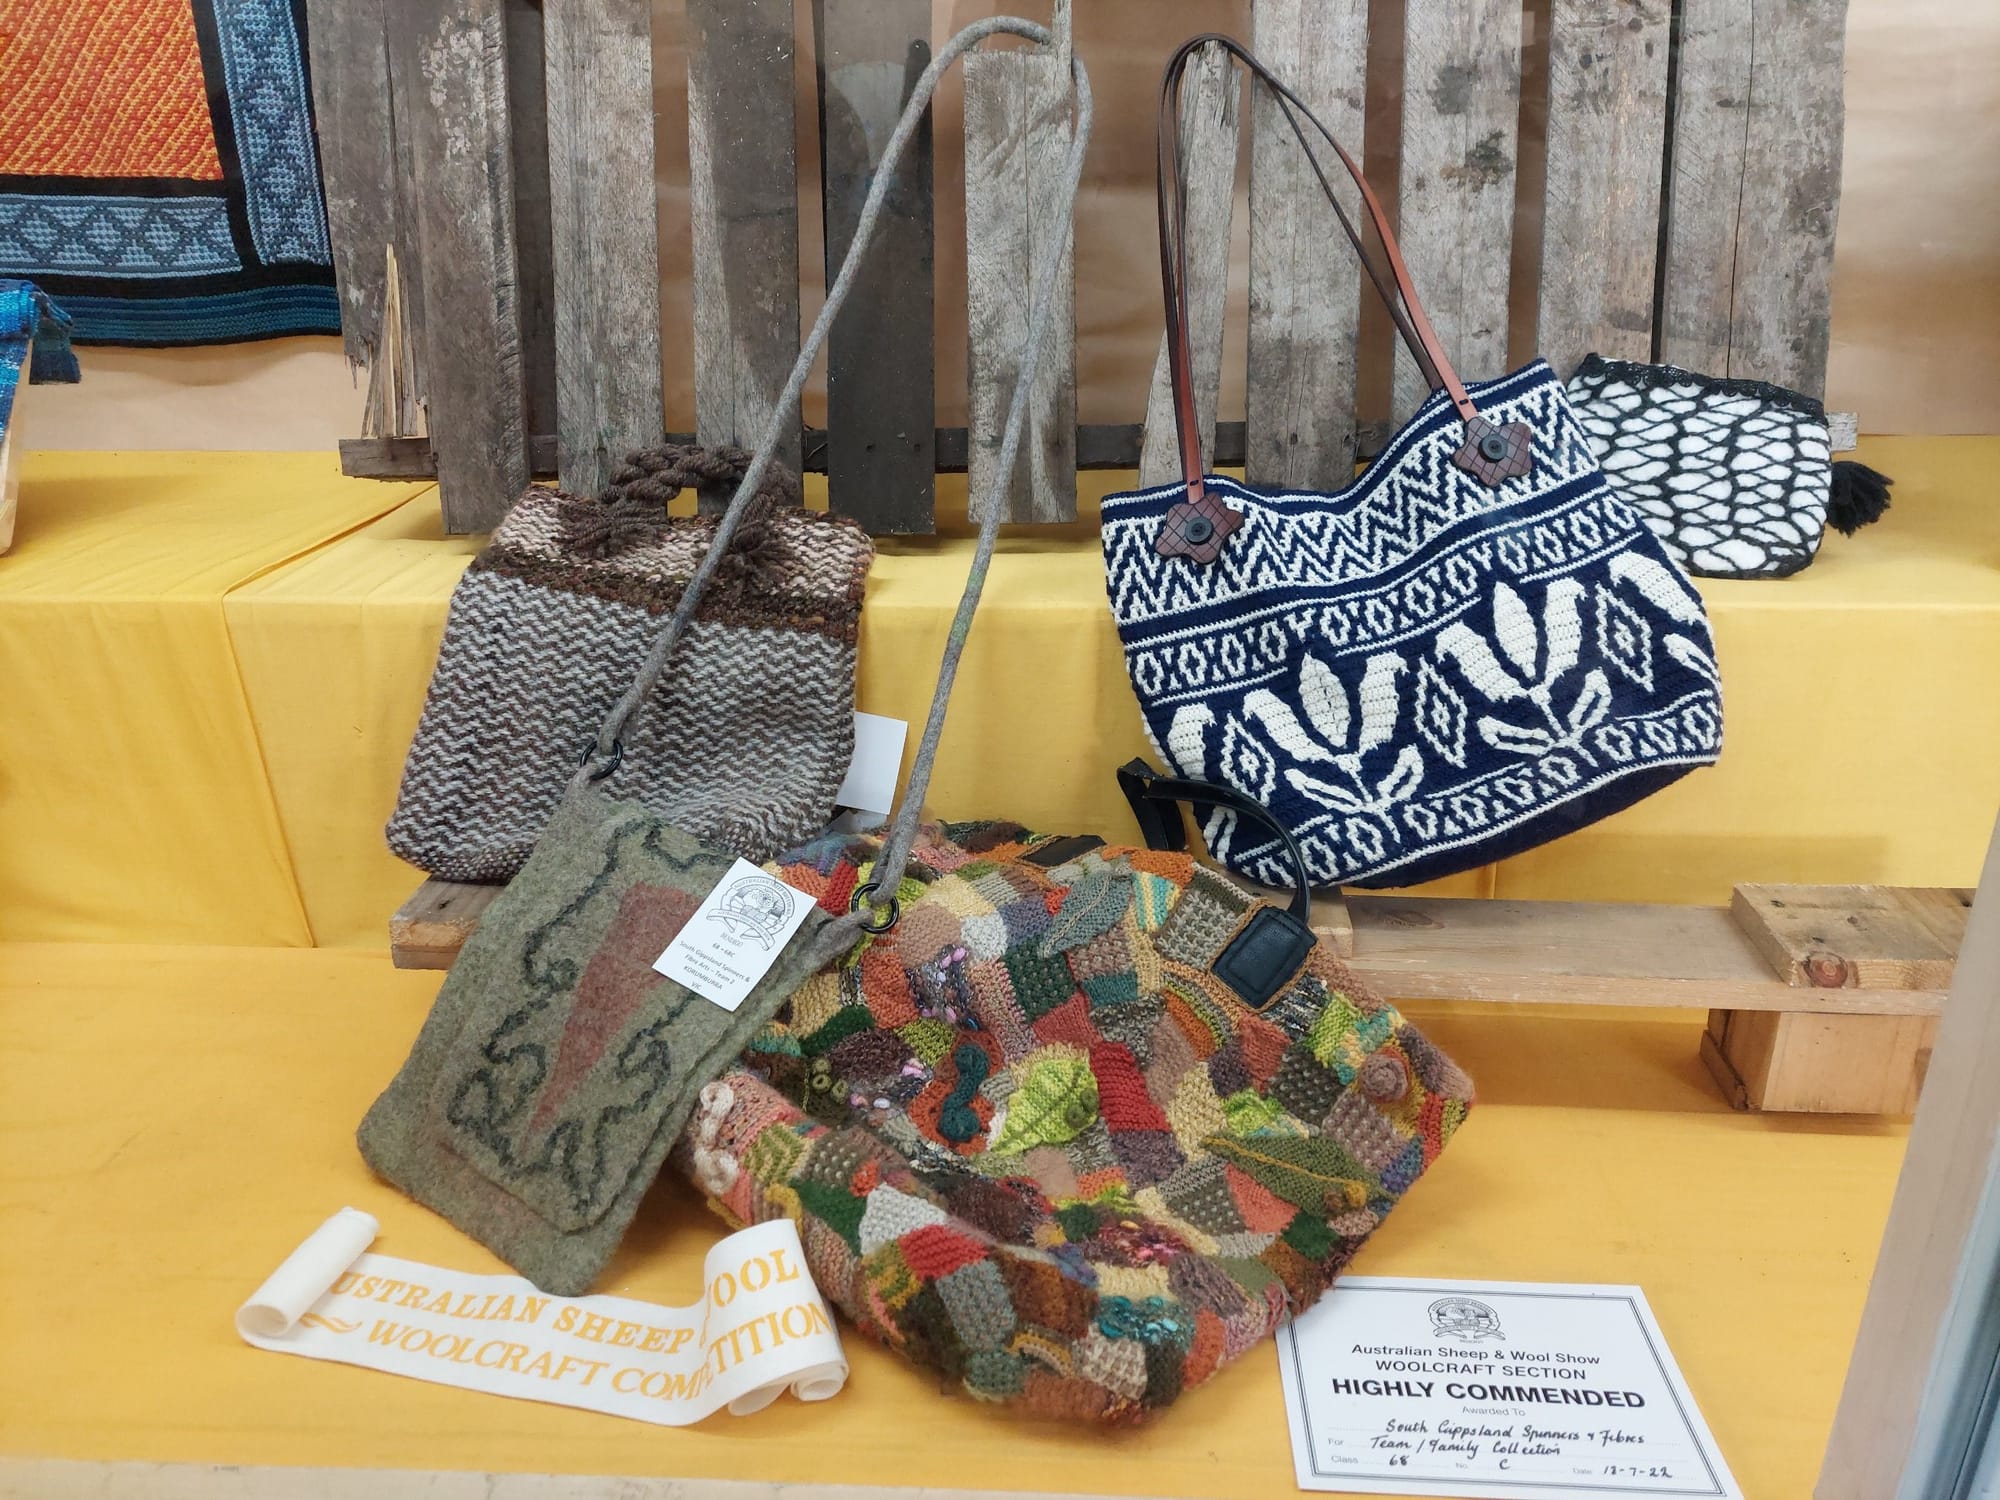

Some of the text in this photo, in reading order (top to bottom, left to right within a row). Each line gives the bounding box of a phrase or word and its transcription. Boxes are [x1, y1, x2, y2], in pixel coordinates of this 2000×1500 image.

[680, 940, 696, 953] South
[330, 1271, 551, 1324] USTRALIAN
[552, 1305, 695, 1356] SHEEP
[368, 1318, 610, 1387] WOOLCRAFT
[1351, 1344, 1601, 1365] Australian Sheep & Wool Show
[1375, 1359, 1587, 1380] WOOLCRAFT SECTION
[1332, 1378, 1646, 1409] HIGHLY COMMENDED
[1462, 1406, 1526, 1417] Awarded To
[1385, 1418, 1429, 1434] South
[1328, 1438, 1344, 1447] For
[1370, 1434, 1412, 1450] Team
[1331, 1455, 1359, 1465] Class
[1388, 1454, 1410, 1467] 68
